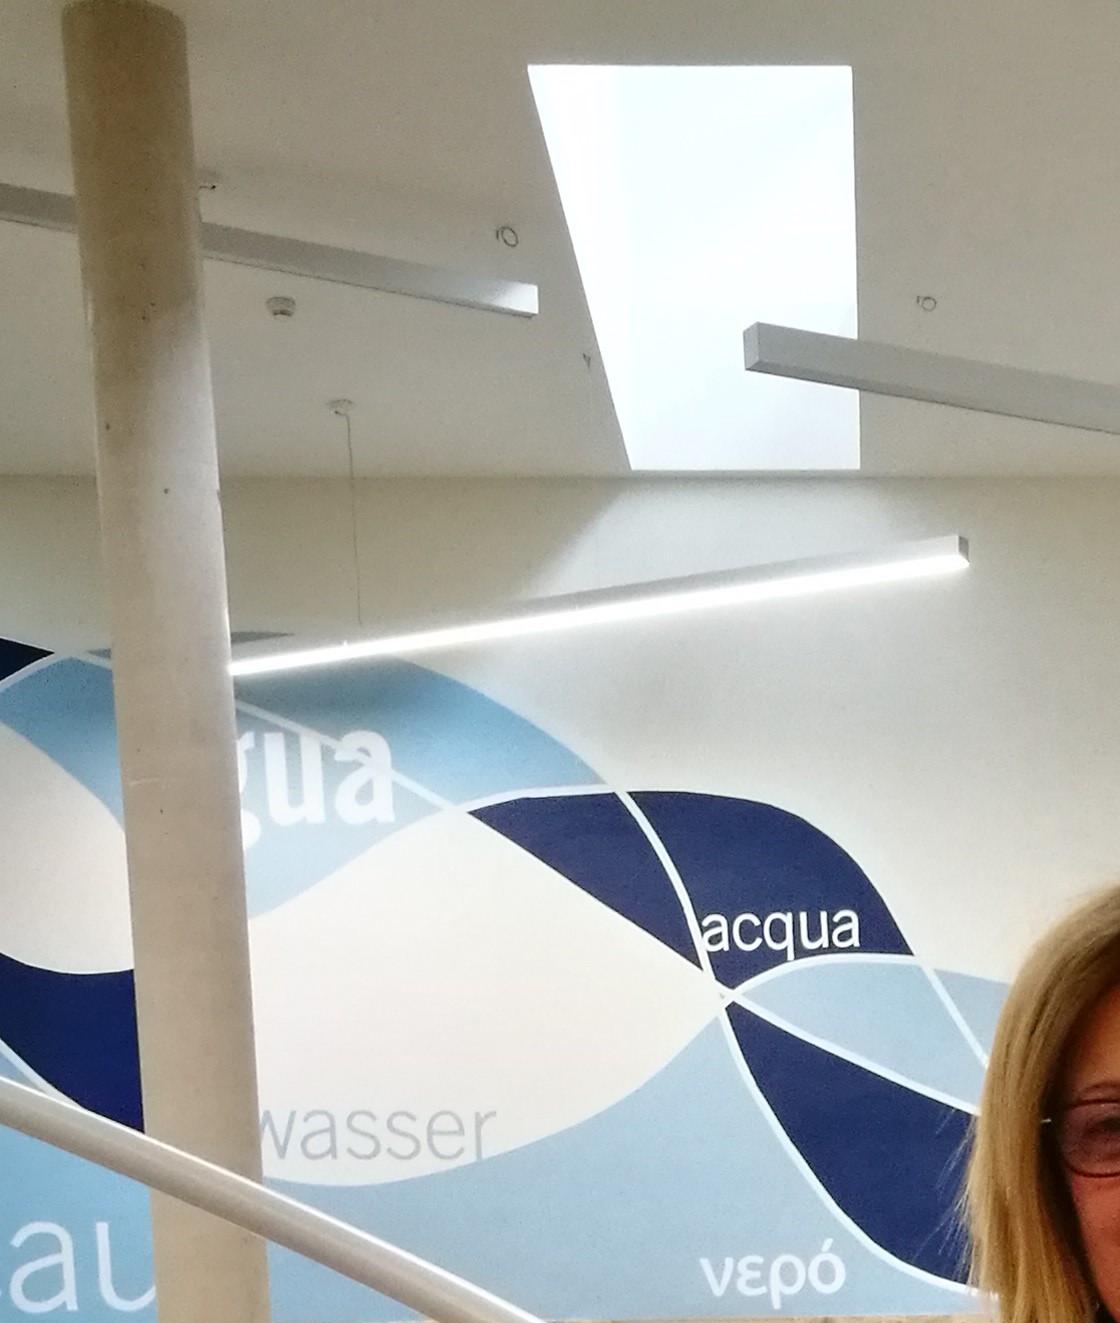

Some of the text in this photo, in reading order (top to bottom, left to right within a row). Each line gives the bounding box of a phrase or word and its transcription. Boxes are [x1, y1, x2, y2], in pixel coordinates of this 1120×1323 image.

[236, 729, 396, 852] ua
[702, 906, 861, 961] acqua
[259, 1108, 497, 1161] wasser
[0, 1220, 157, 1314] au
[699, 1237, 847, 1310] νερό
